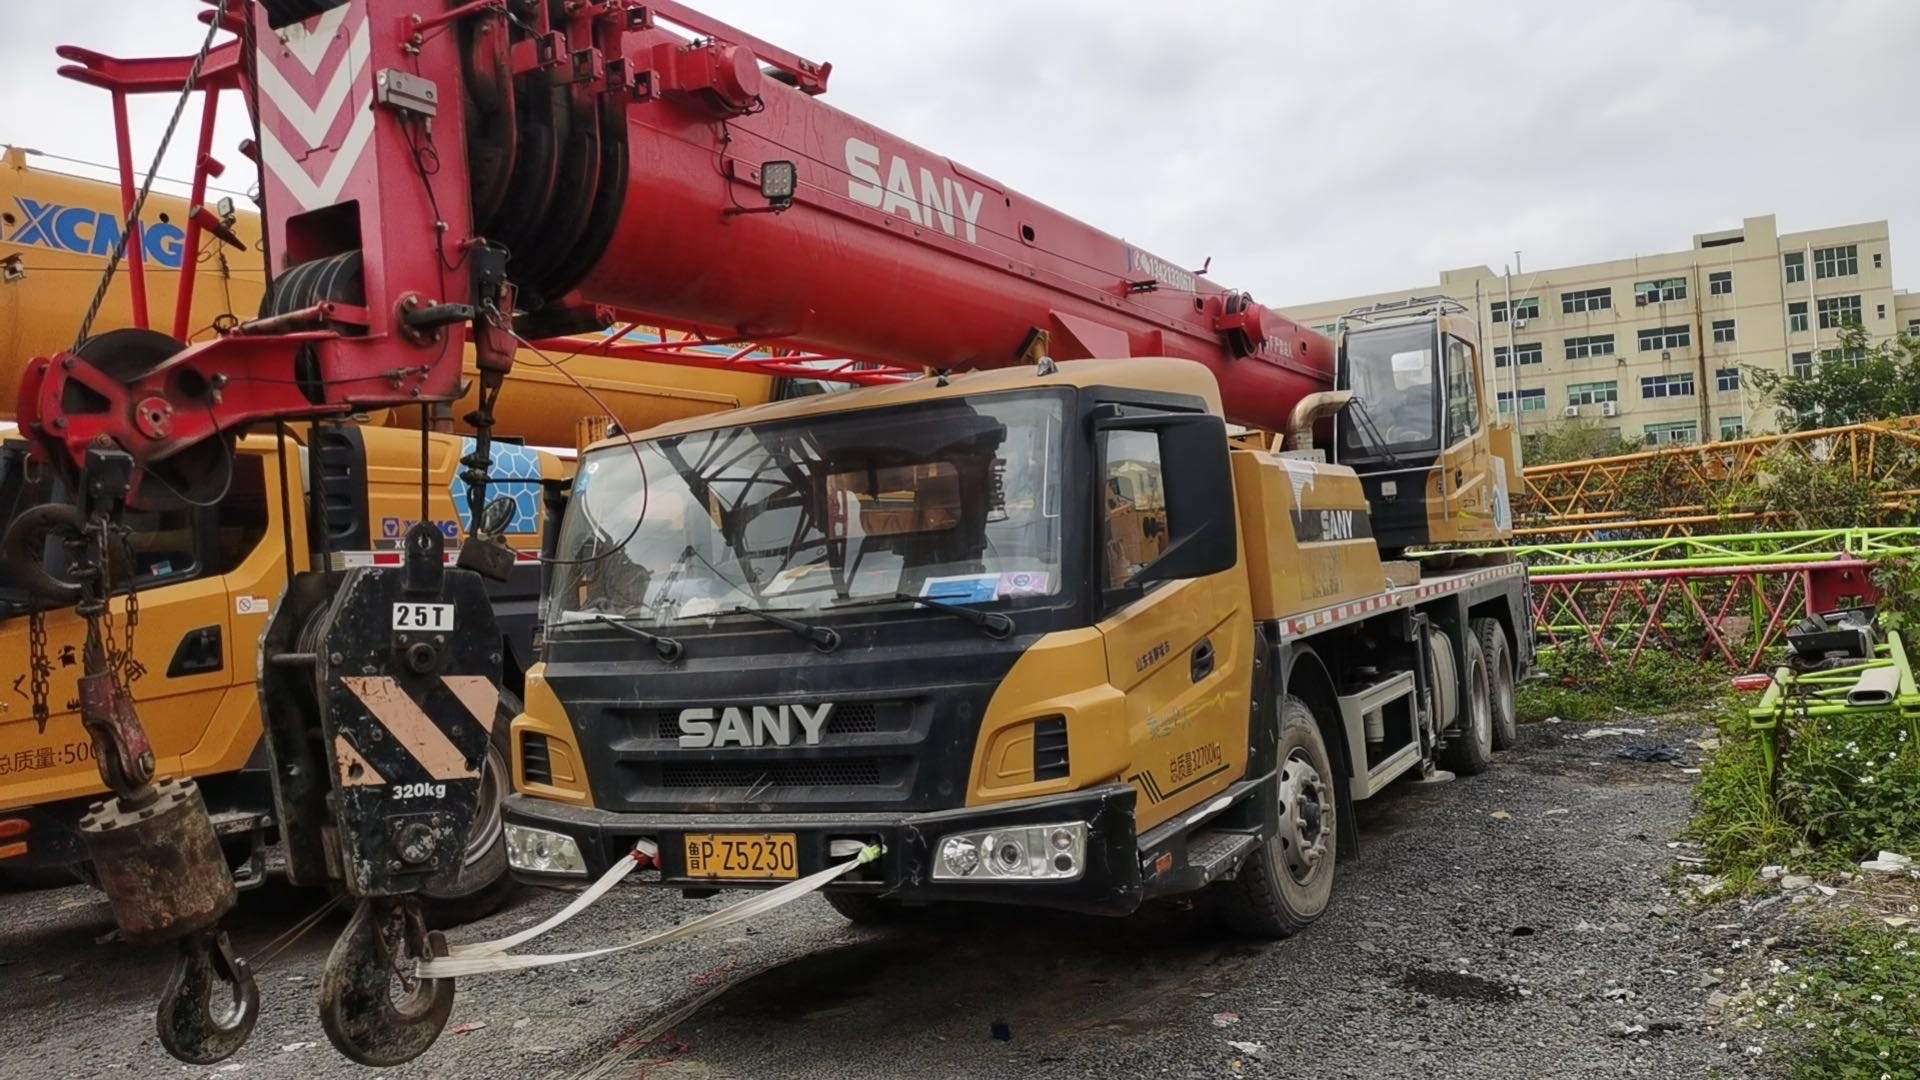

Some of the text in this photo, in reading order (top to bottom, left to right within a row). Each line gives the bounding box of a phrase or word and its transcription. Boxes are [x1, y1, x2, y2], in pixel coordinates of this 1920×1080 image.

[845, 137, 984, 244] SANY
[12, 196, 187, 269] XCMG
[1320, 510, 1353, 540] SANY
[397, 605, 444, 627] 25T
[678, 703, 833, 748] SANY
[392, 782, 446, 799] 320kg
